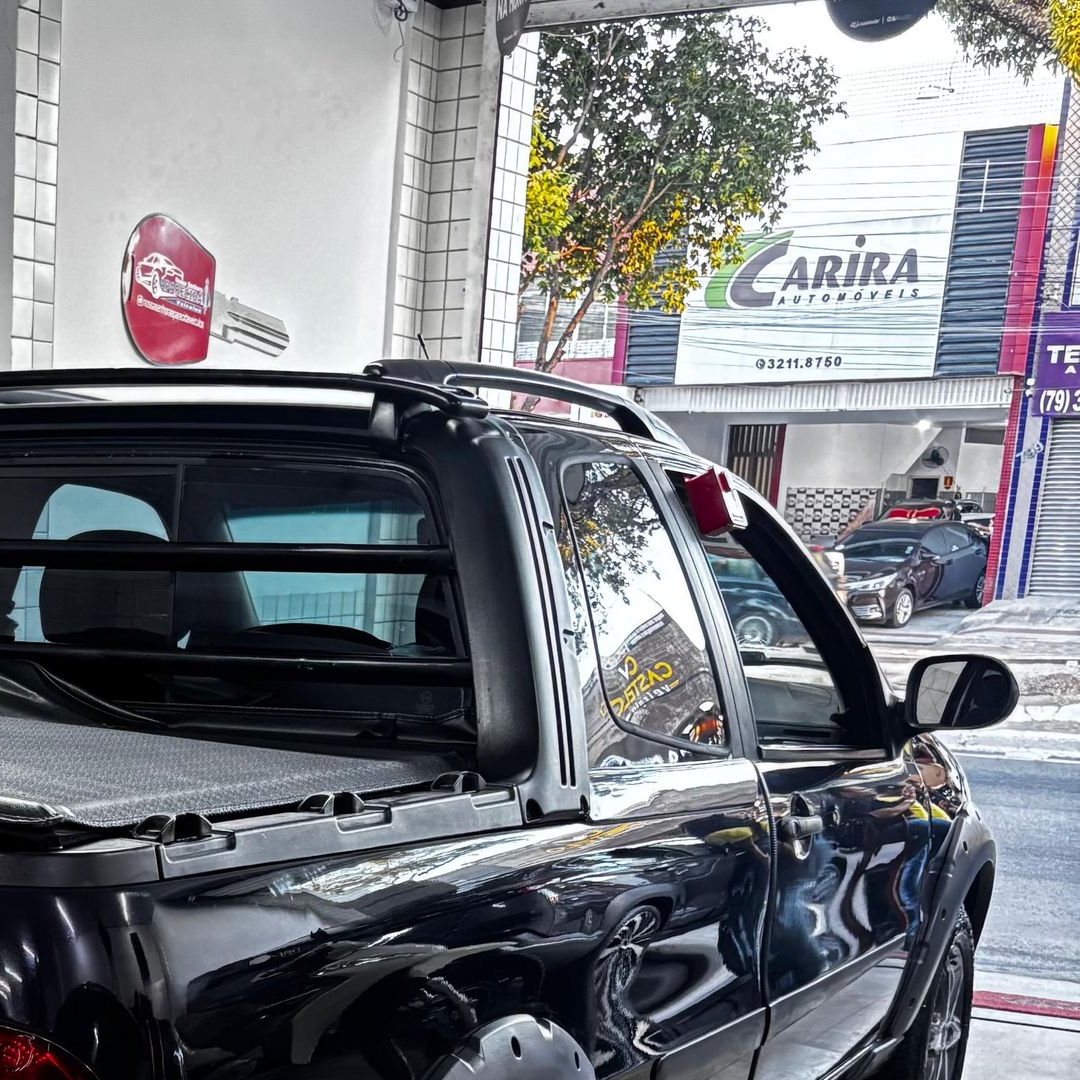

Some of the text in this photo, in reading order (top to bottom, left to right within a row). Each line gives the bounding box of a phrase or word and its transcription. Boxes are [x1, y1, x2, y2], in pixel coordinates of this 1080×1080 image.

[777, 288, 920, 306] AUTOMÓVEIS
[767, 356, 843, 370] 3211.8750
[1040, 389, 1070, 414] (79)
